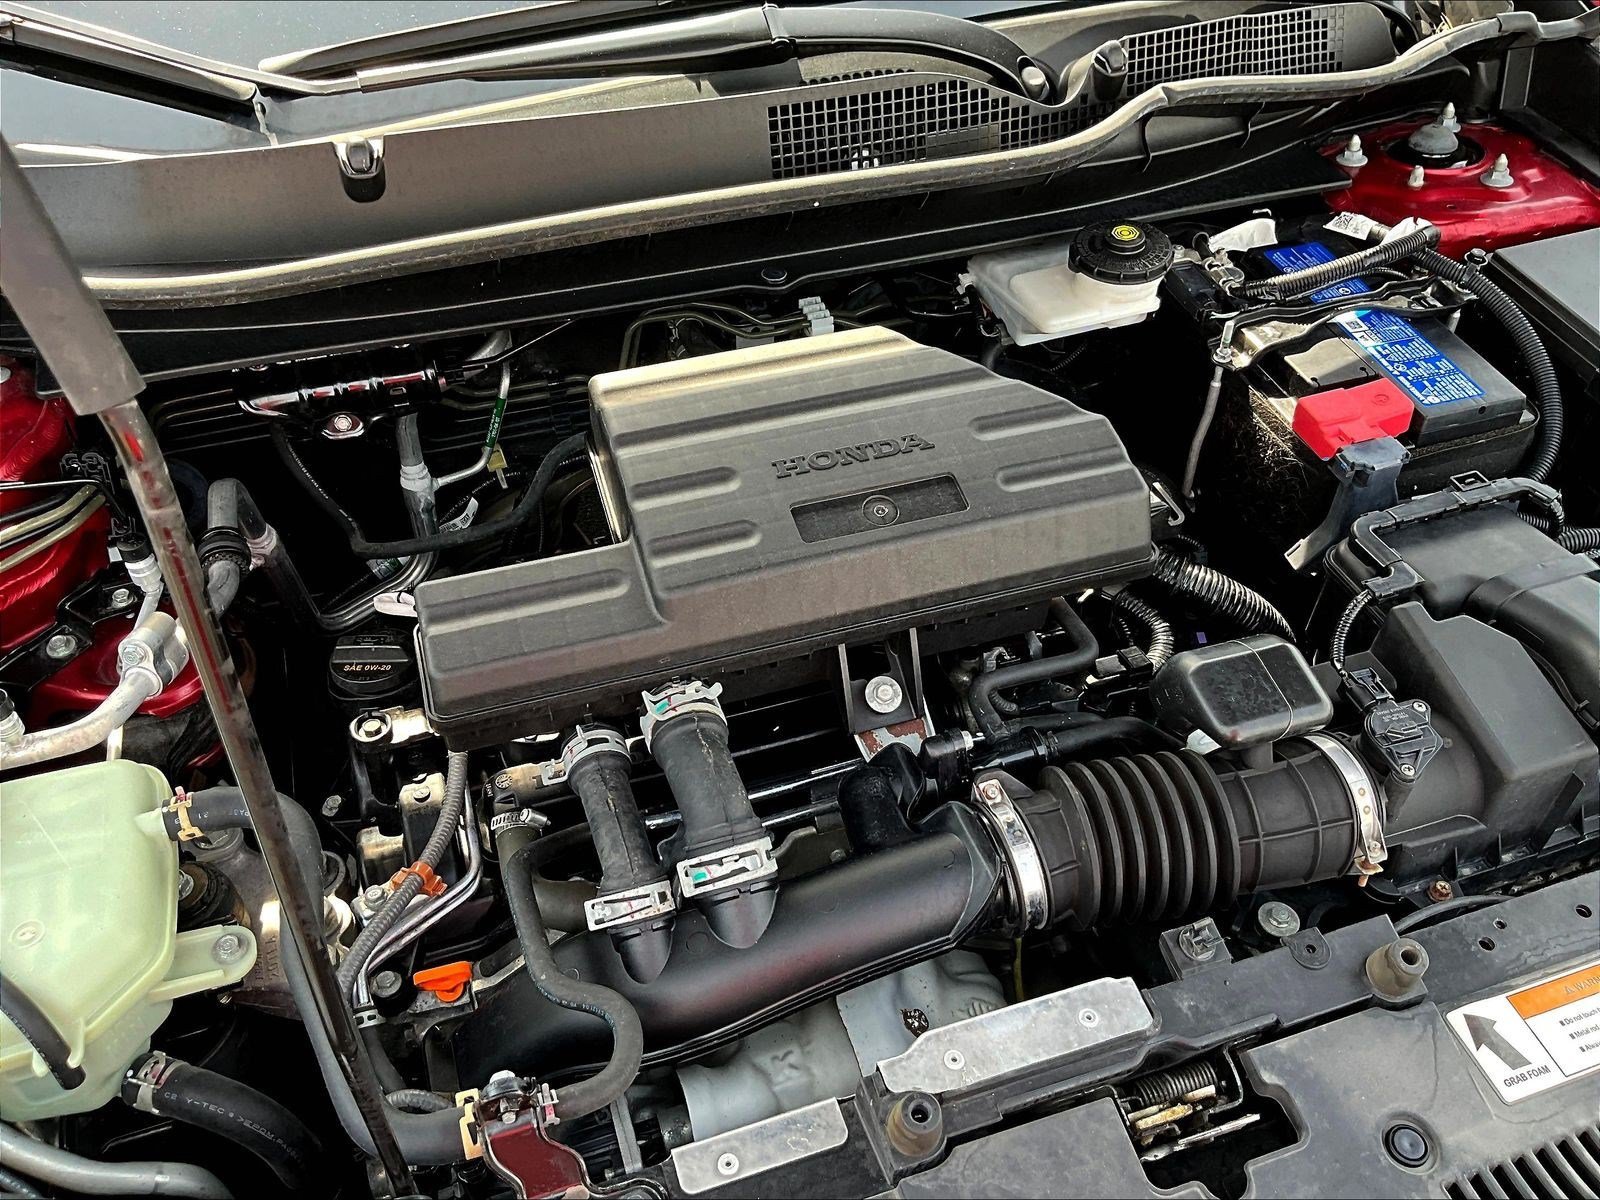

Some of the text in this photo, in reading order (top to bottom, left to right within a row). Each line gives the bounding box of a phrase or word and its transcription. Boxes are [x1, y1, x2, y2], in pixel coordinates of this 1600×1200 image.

[771, 433, 936, 479] HONDA
[1564, 1017, 1574, 1025] Do
[1573, 1013, 1584, 1022] not
[1581, 1009, 1598, 1018] touch
[1573, 1027, 1591, 1038] Metal
[1503, 1065, 1551, 1088] GRAB FOAM
[185, 1097, 225, 1114] Y-TEC
